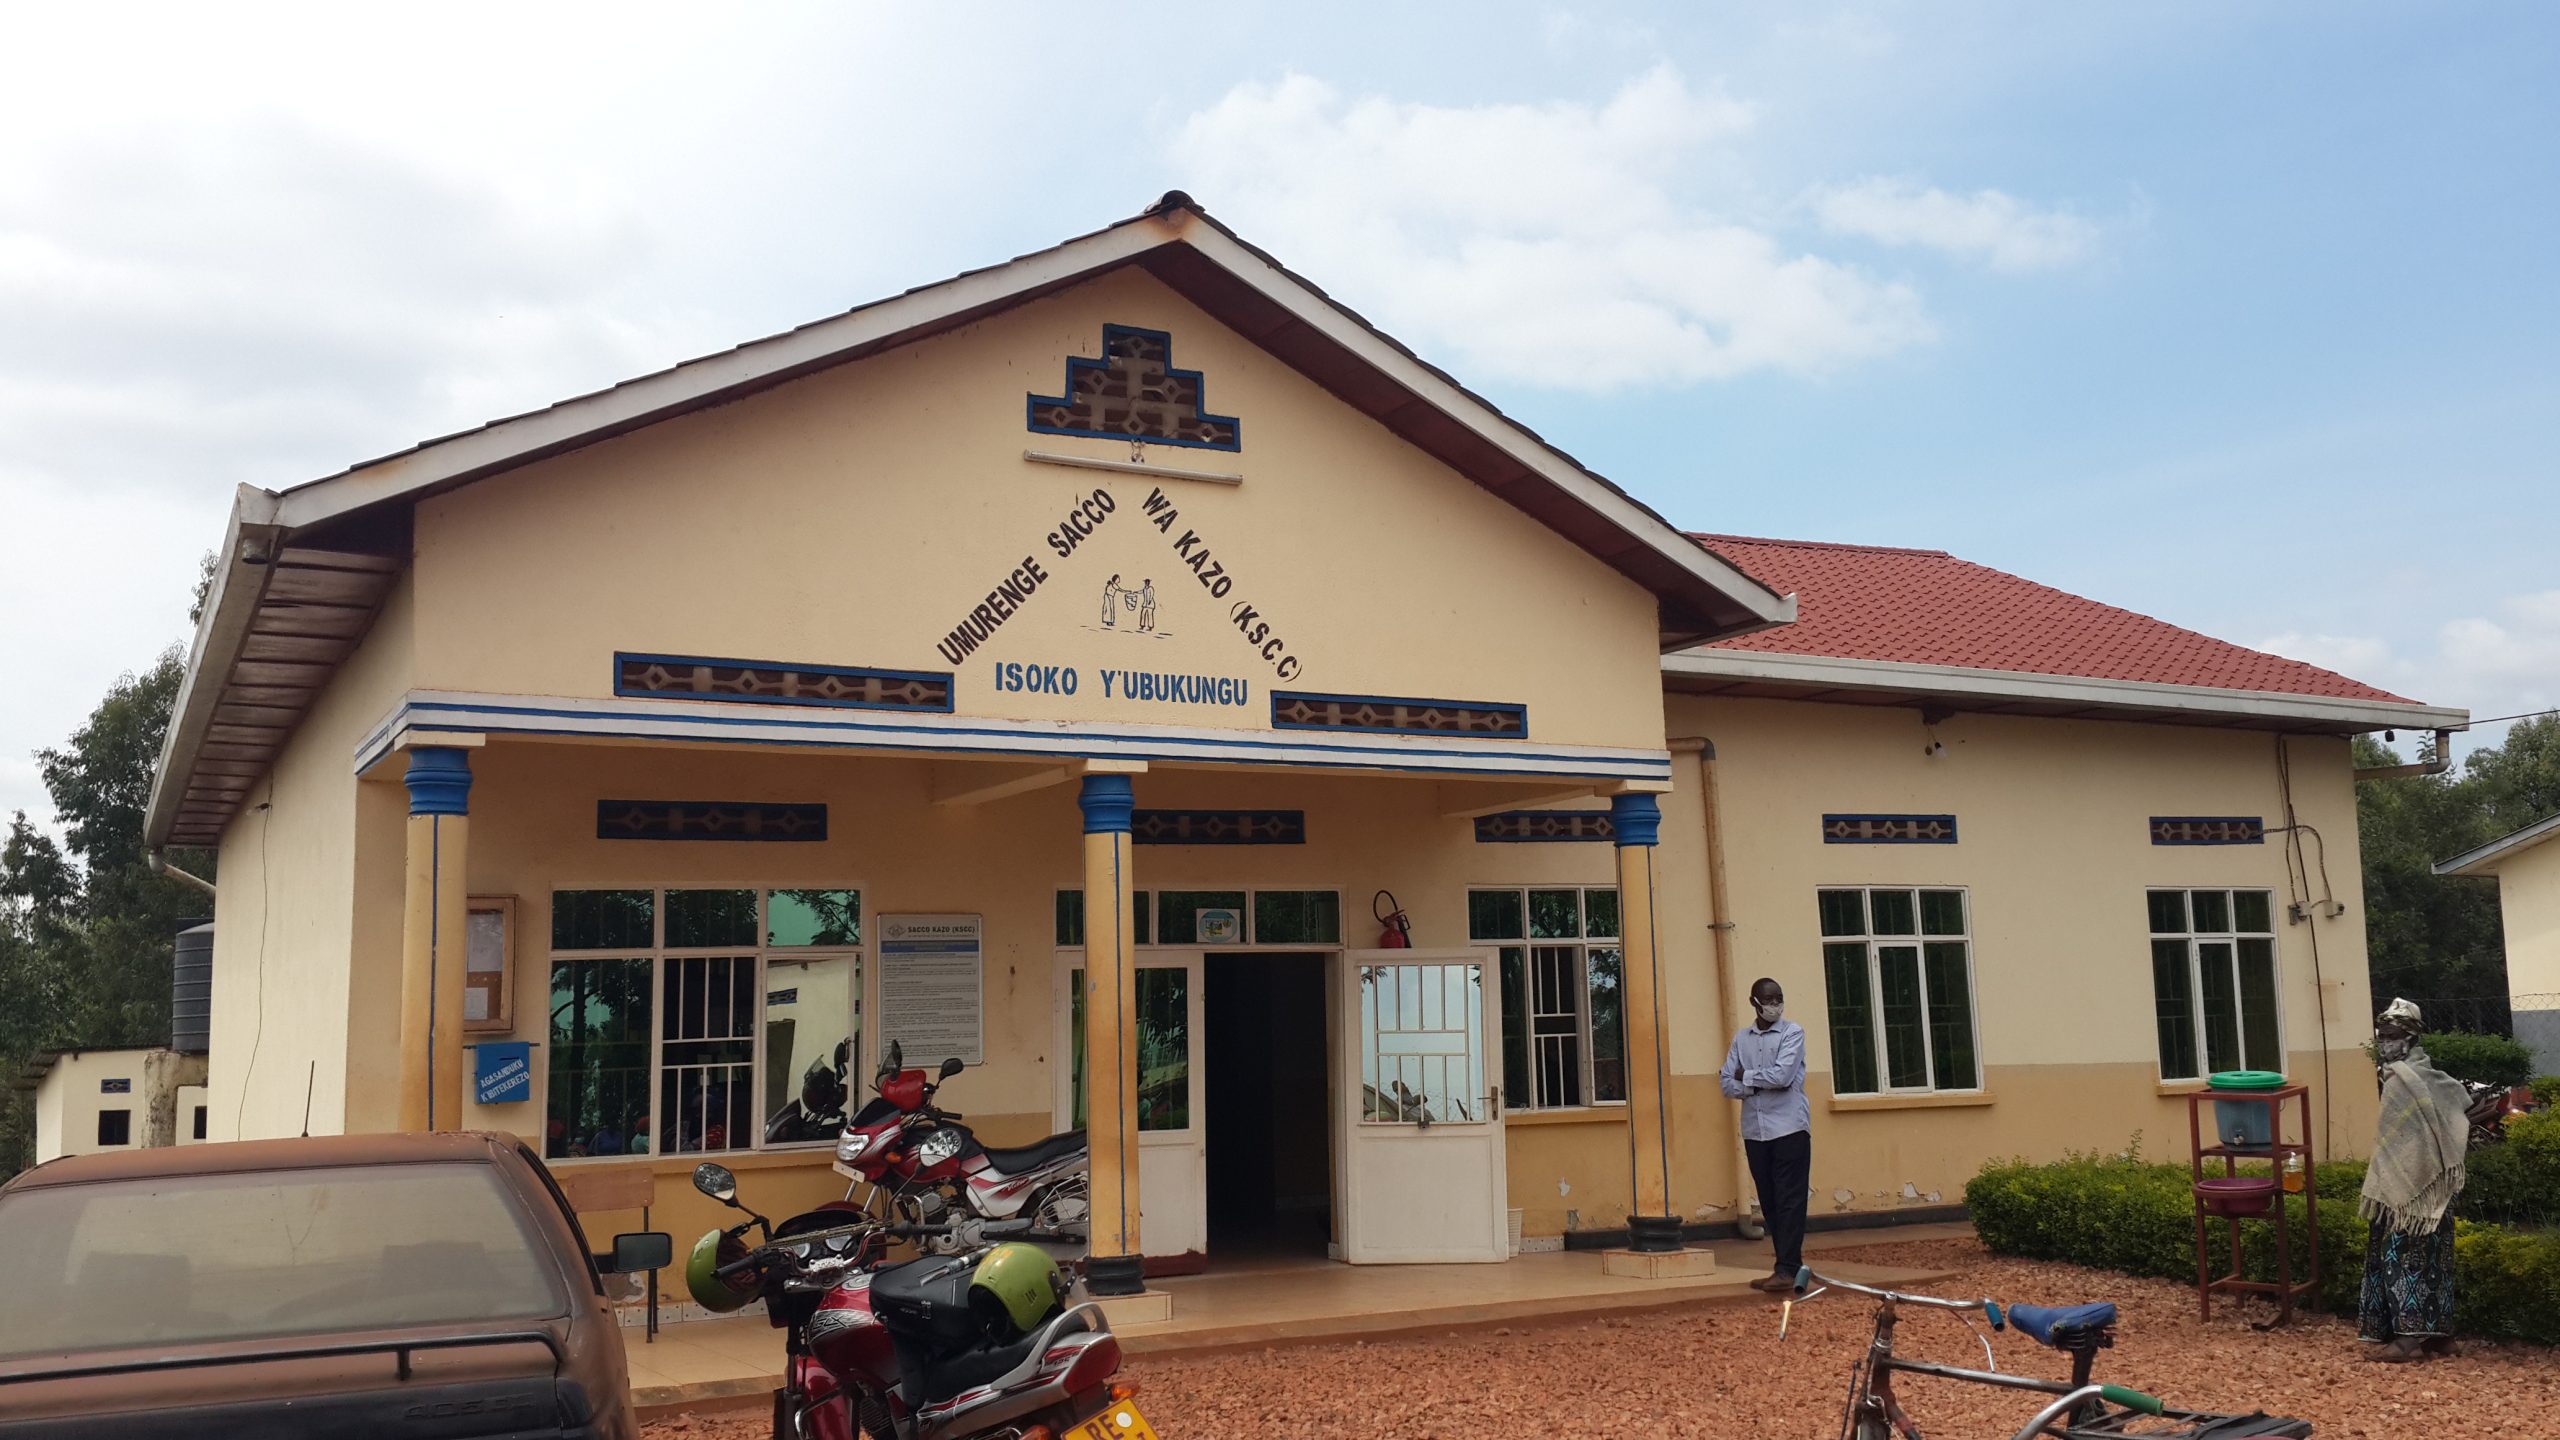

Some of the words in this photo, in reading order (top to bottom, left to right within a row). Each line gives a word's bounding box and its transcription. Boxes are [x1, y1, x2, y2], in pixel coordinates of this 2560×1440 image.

[937, 555, 1049, 666] UMURENGE
[1047, 488, 1117, 558] SACCO
[1141, 487, 1179, 534] WA
[1173, 529, 1233, 599] KAZO
[1229, 600, 1303, 683] (K.S.C.C)
[995, 662, 1078, 696] ISOKO
[1100, 669, 1248, 707] Y'UBUKUNGU
[907, 926, 931, 934] SACCO
